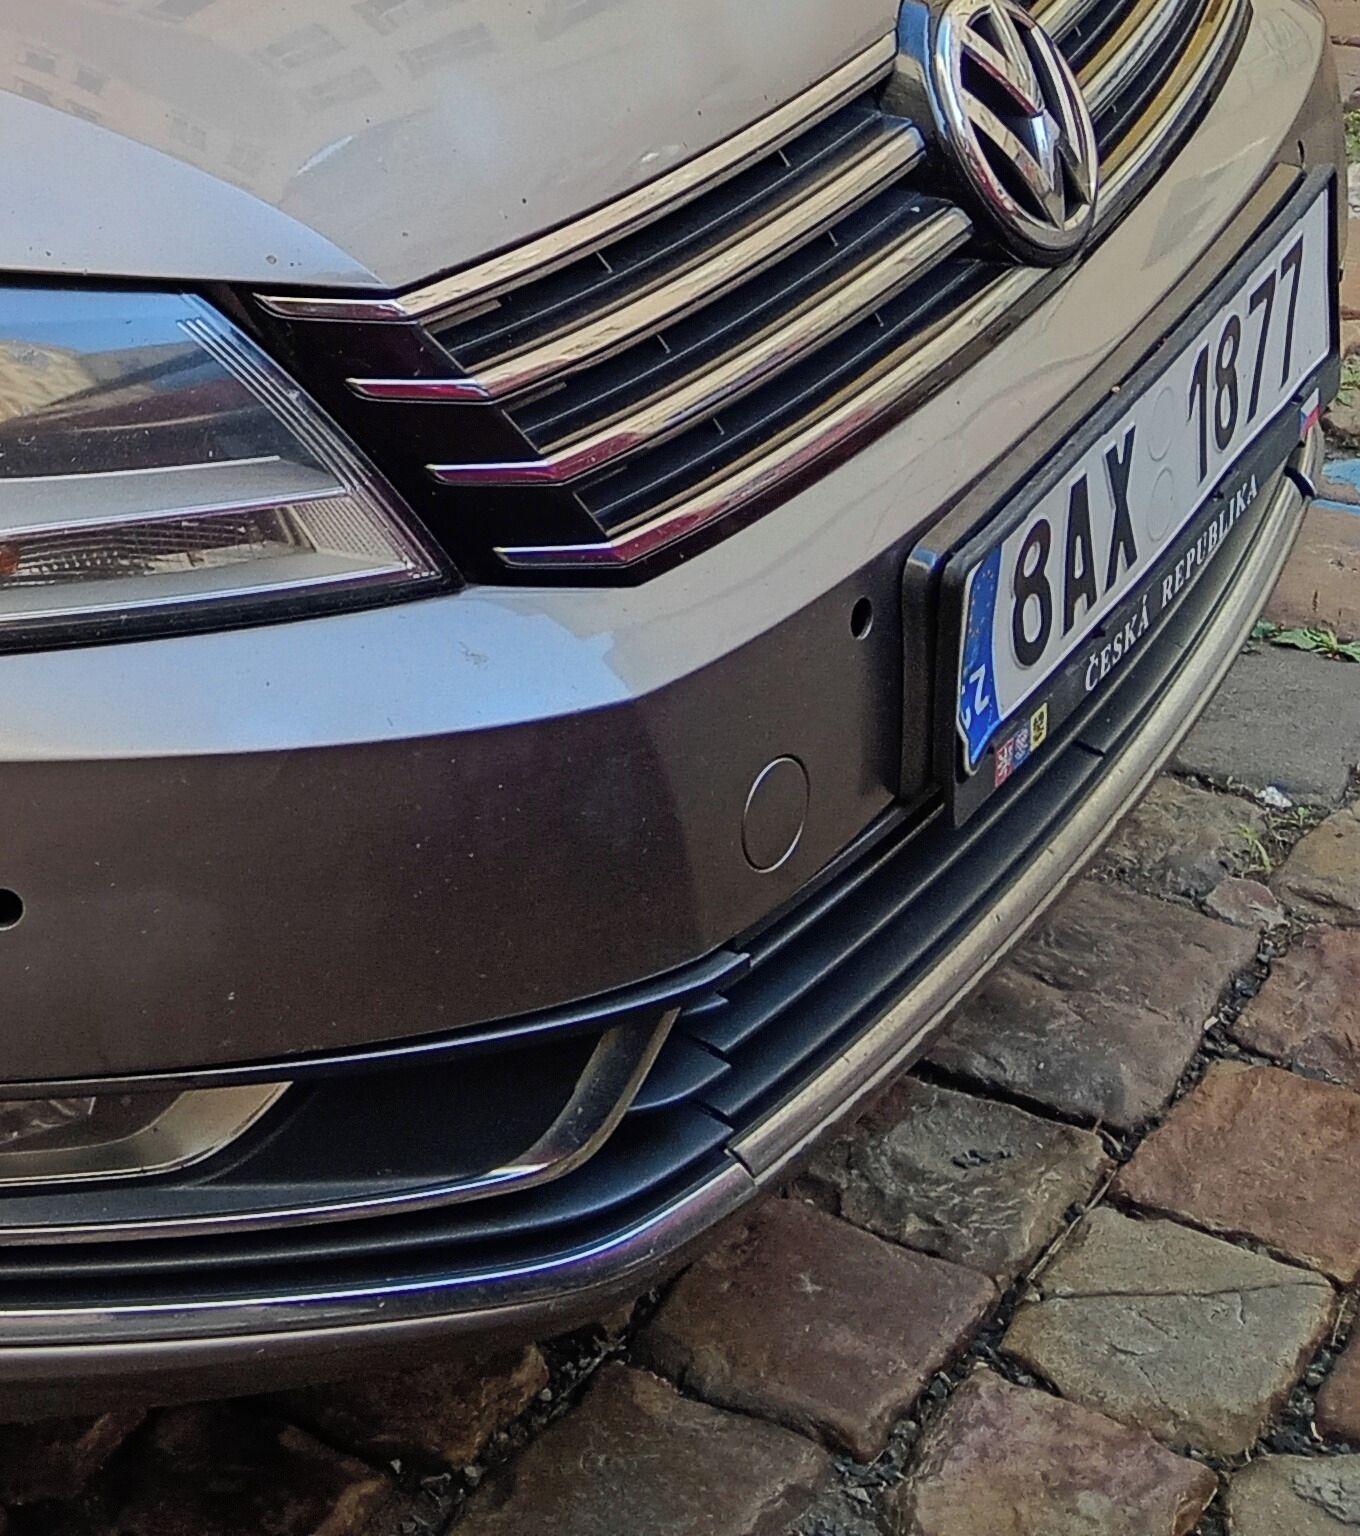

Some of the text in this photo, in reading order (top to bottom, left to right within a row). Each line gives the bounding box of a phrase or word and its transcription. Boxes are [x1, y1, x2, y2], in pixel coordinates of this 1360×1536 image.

[1011, 231, 1305, 668] 8AX 1877
[1084, 474, 1258, 692] ČESKÁ REPUBLIKA
